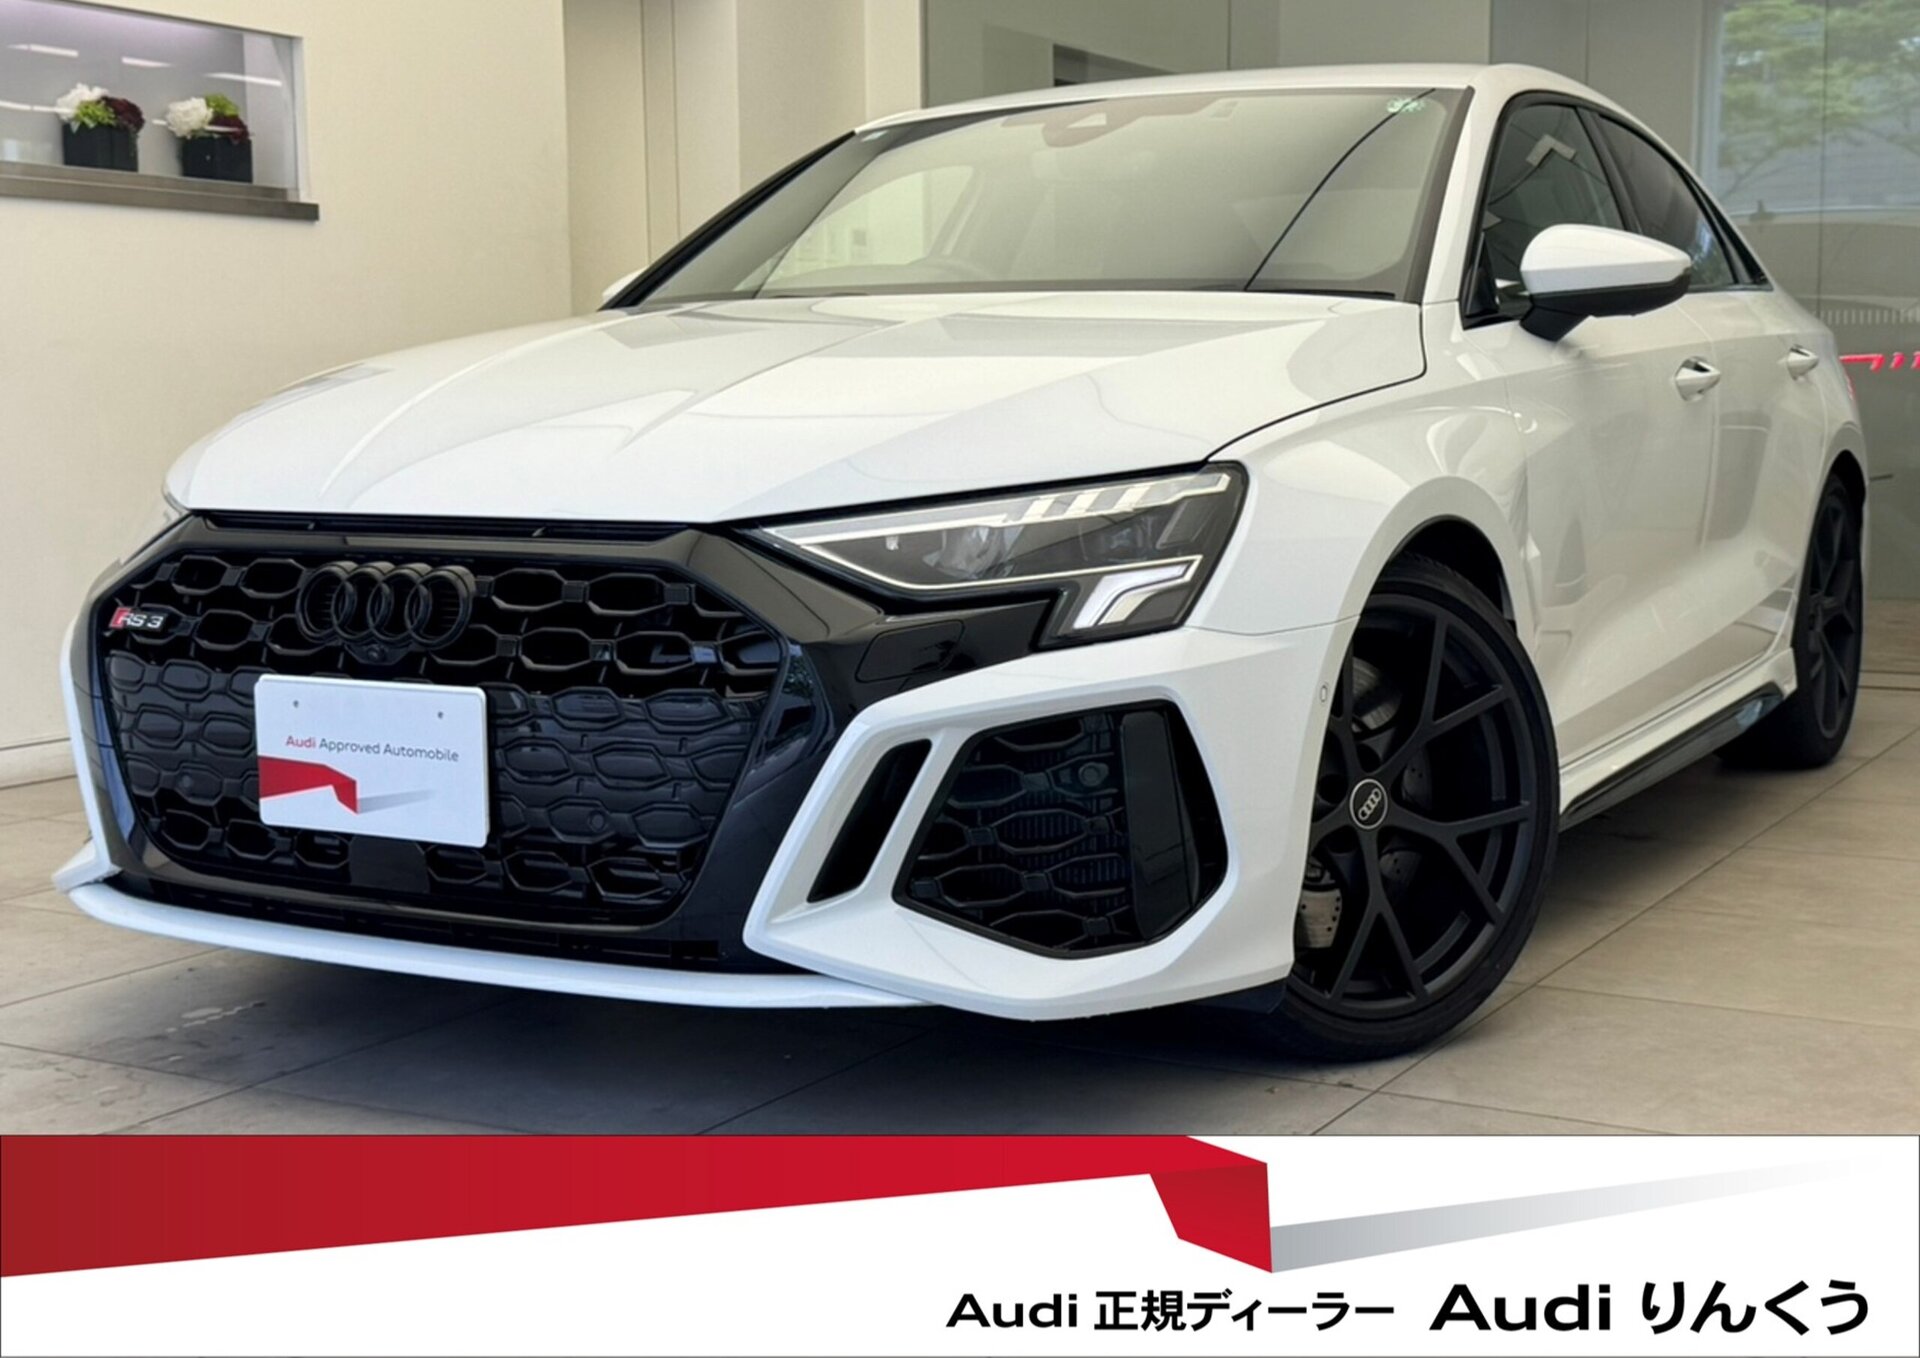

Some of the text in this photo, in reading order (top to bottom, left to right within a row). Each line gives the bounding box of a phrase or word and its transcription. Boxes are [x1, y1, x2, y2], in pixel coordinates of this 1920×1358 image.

[285, 735, 459, 762] Audi Approved Automobile
